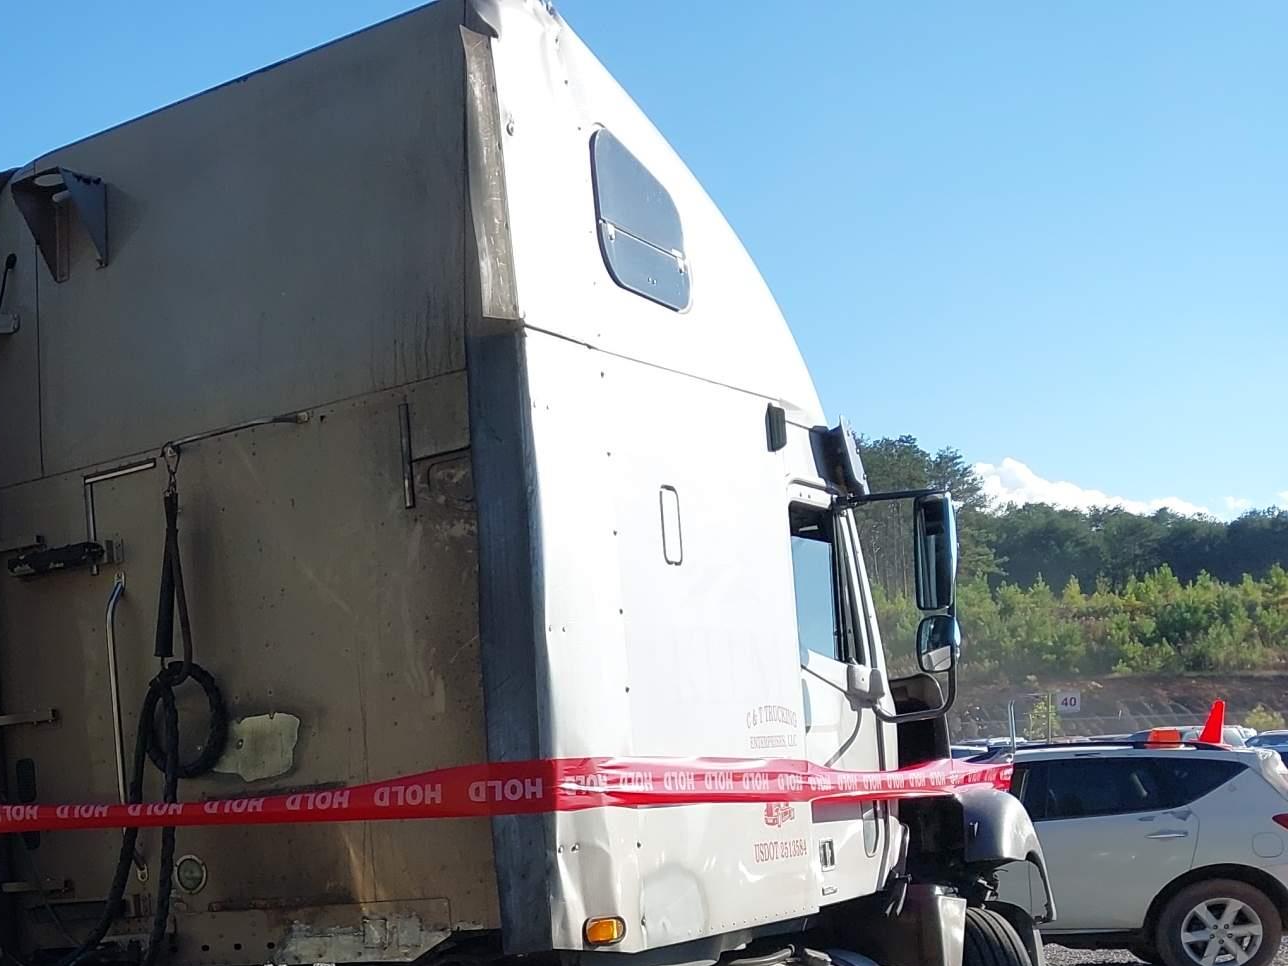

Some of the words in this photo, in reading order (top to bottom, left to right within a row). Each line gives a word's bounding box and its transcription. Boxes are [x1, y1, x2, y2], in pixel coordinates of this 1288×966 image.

[1061, 696, 1077, 707] 40
[285, 790, 350, 811] HOLD
[373, 783, 442, 807] HOLD
[468, 777, 543, 802] HOLD
[663, 771, 696, 791] HOLD
[704, 771, 734, 791] HOLD
[742, 772, 769, 791] HOLD
[753, 841, 779, 863] USDOT
